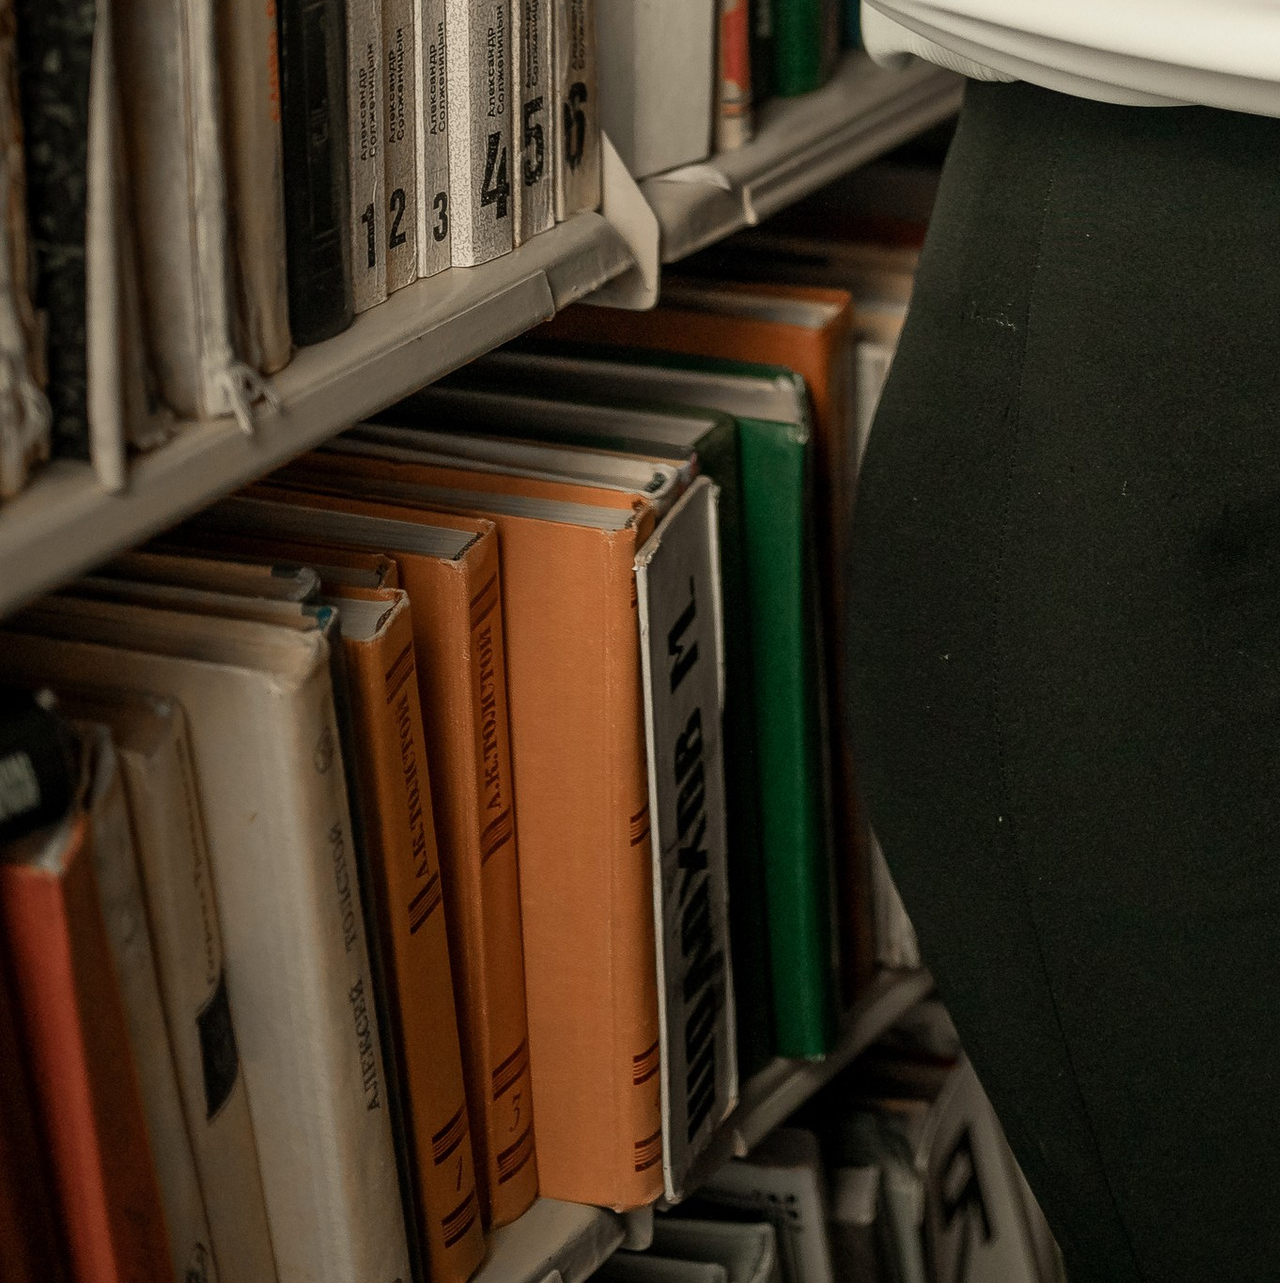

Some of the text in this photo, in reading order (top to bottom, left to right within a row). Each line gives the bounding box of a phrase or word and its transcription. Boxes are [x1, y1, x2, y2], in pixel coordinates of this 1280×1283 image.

[523, 94, 545, 188] 5
[563, 81, 588, 173] 6
[388, 187, 407, 250] 2
[432, 191, 448, 243] 3
[480, 130, 508, 220] 4
[361, 202, 376, 268] 1
[329, 822, 380, 1113] АЛЕКСЕЙ ТОЛСТОЙ
[674, 706, 724, 1144] ШОЛОХОВ
[509, 1090, 523, 1133] 3
